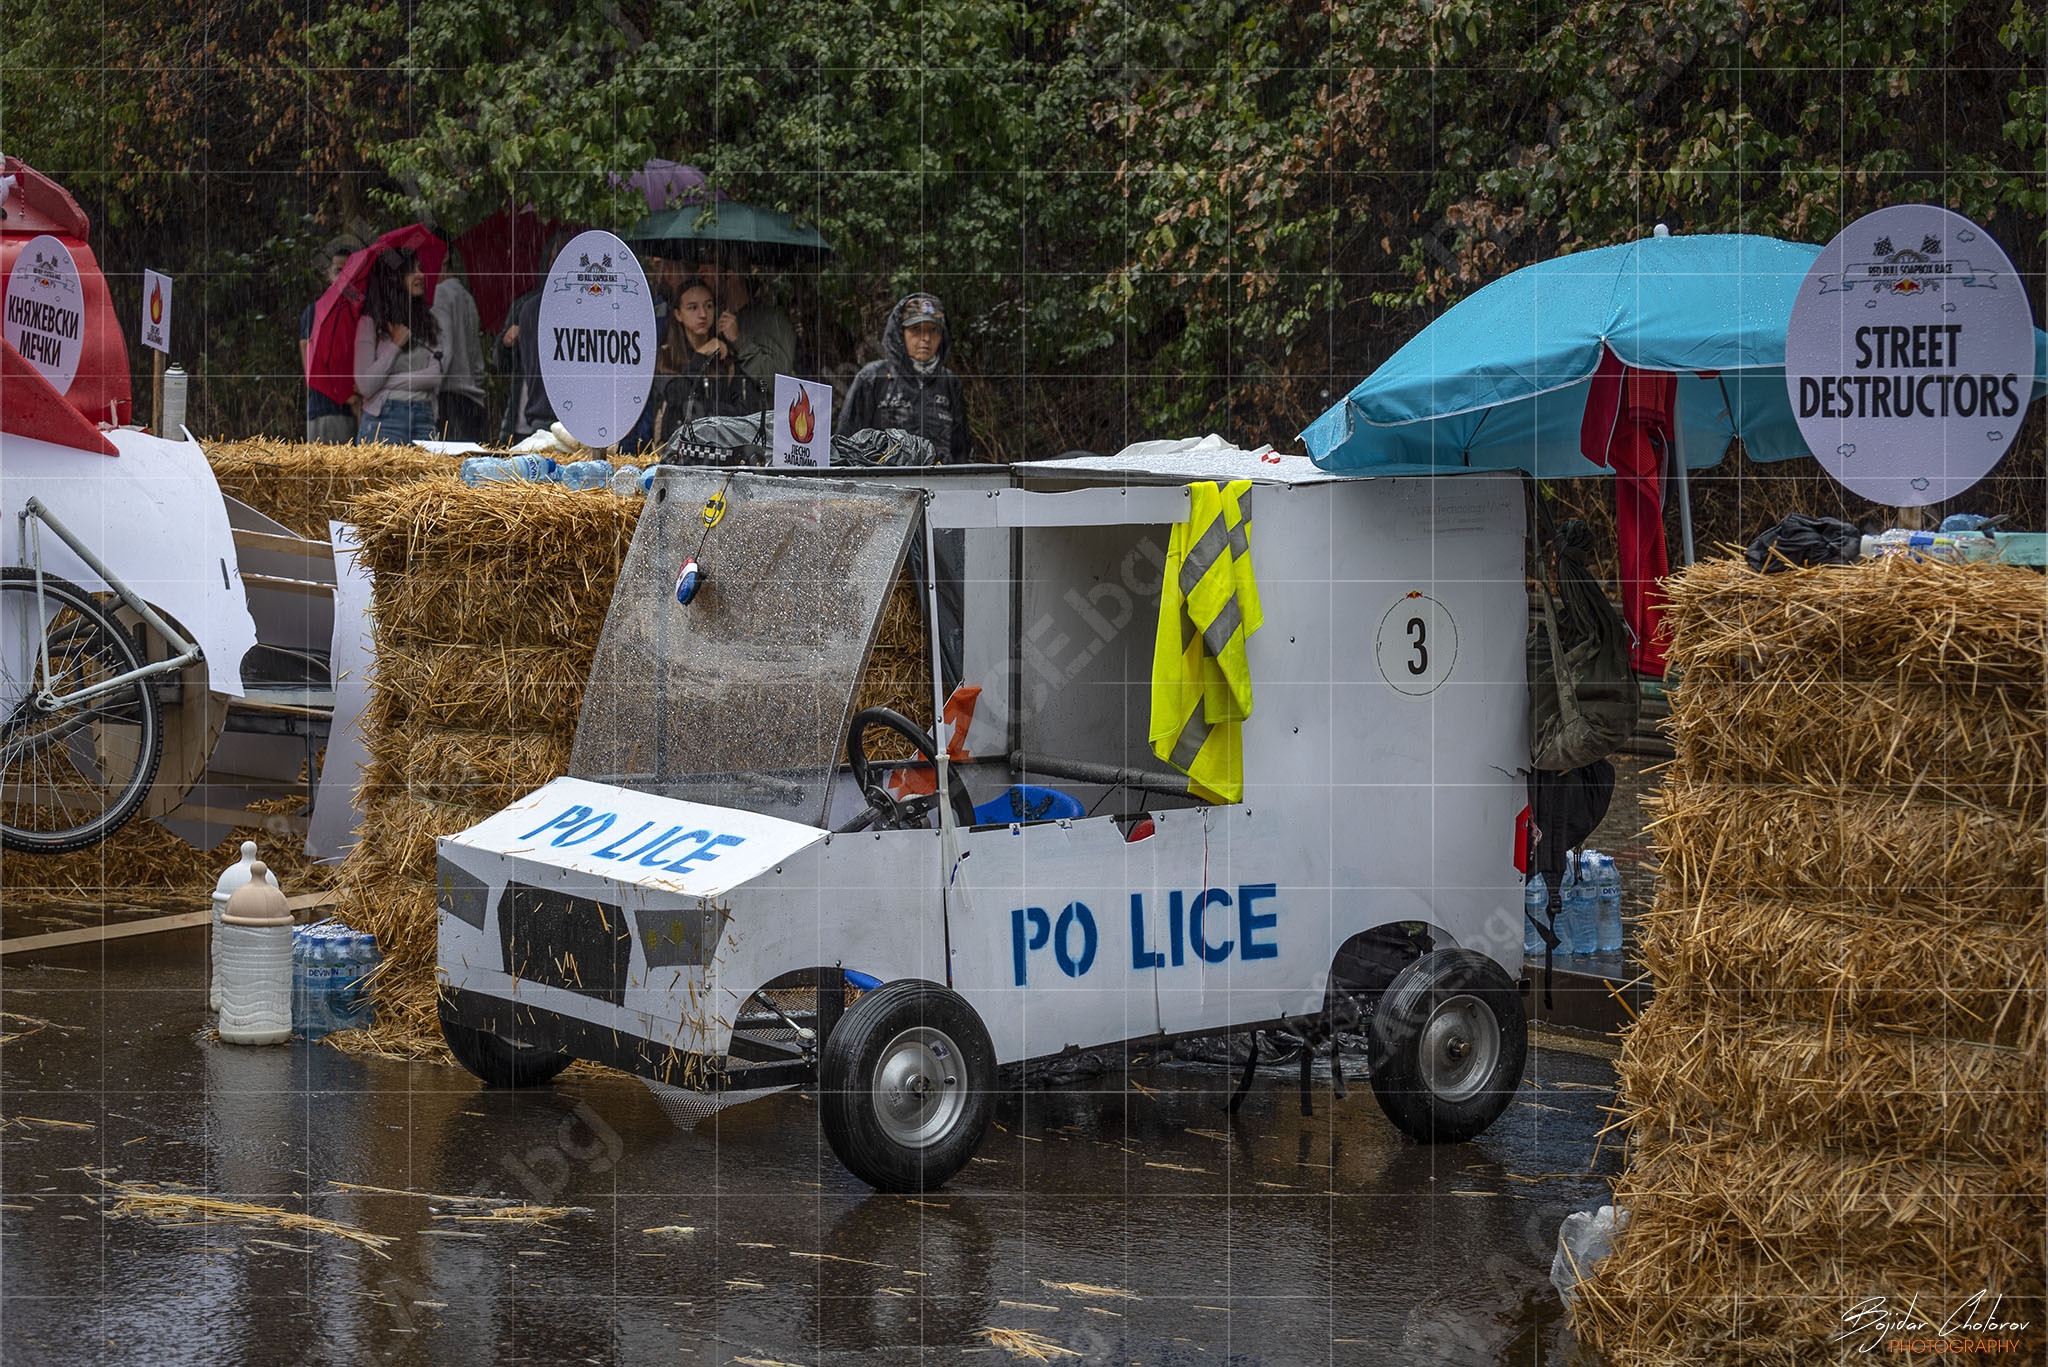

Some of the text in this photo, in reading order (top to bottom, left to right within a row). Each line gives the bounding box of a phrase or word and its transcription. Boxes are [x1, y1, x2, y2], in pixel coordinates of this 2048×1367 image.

[1868, 263, 1953, 277] RED BULL SOAPBOX RACE
[8, 294, 80, 340] КНЯЖЕВСКИ
[19, 330, 62, 367] МЕЧКИ
[552, 327, 641, 365] XVENTORS
[1855, 325, 1962, 369] STREET
[1799, 374, 2020, 418] DESTRUCTORS
[528, 457, 537, 479] DEVIN
[783, 452, 818, 467] ЗАПАЛИМО
[791, 444, 811, 458] ЛЕСНО
[1406, 617, 1428, 675] 3
[308, 968, 331, 977] DEVIN
